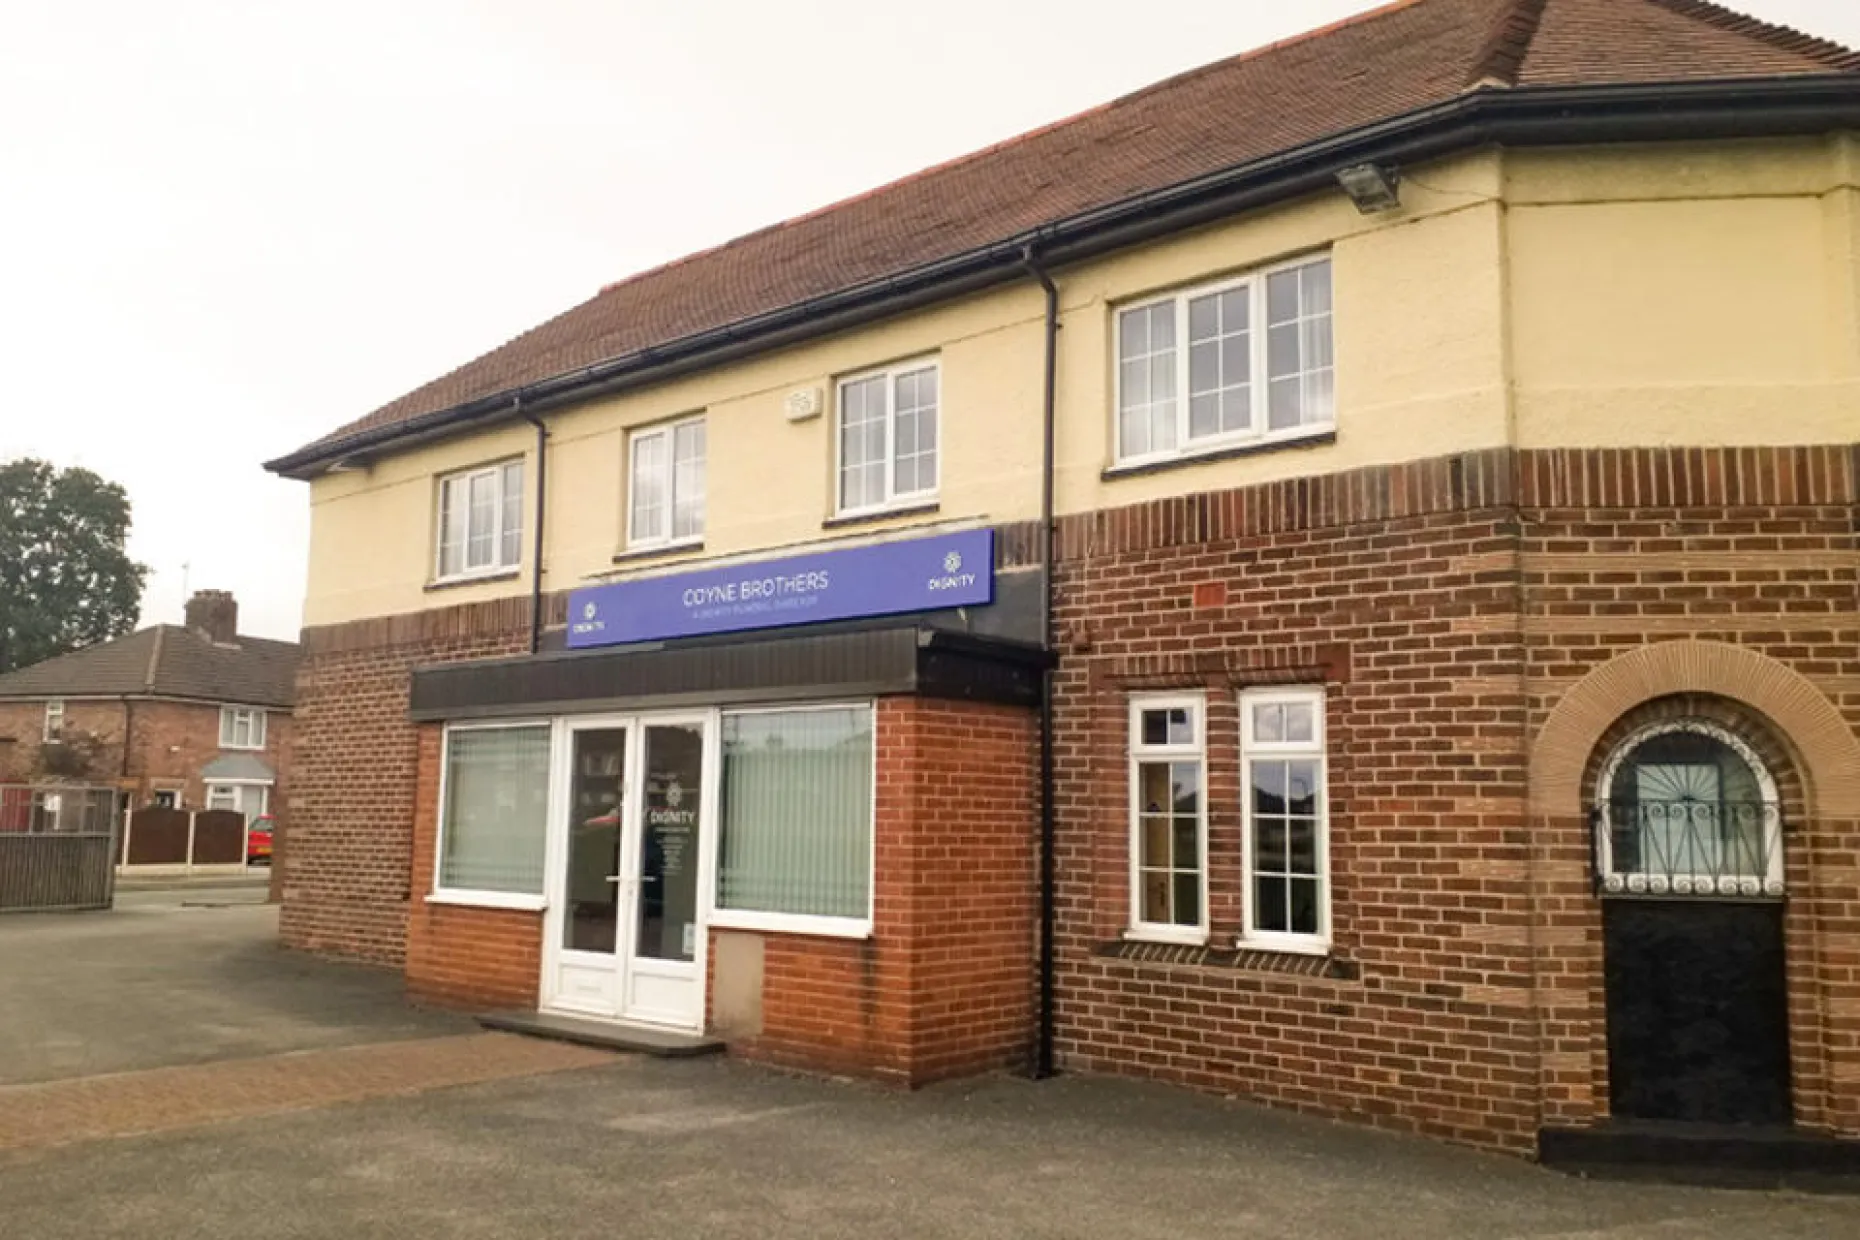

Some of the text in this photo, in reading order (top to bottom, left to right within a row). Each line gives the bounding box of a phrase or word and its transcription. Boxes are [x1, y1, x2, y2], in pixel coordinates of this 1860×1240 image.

[683, 583, 737, 607] COYNE
[740, 570, 828, 601] BROTHERS
[928, 573, 975, 591] DIGNITY
[650, 810, 695, 825] DIGNITY
